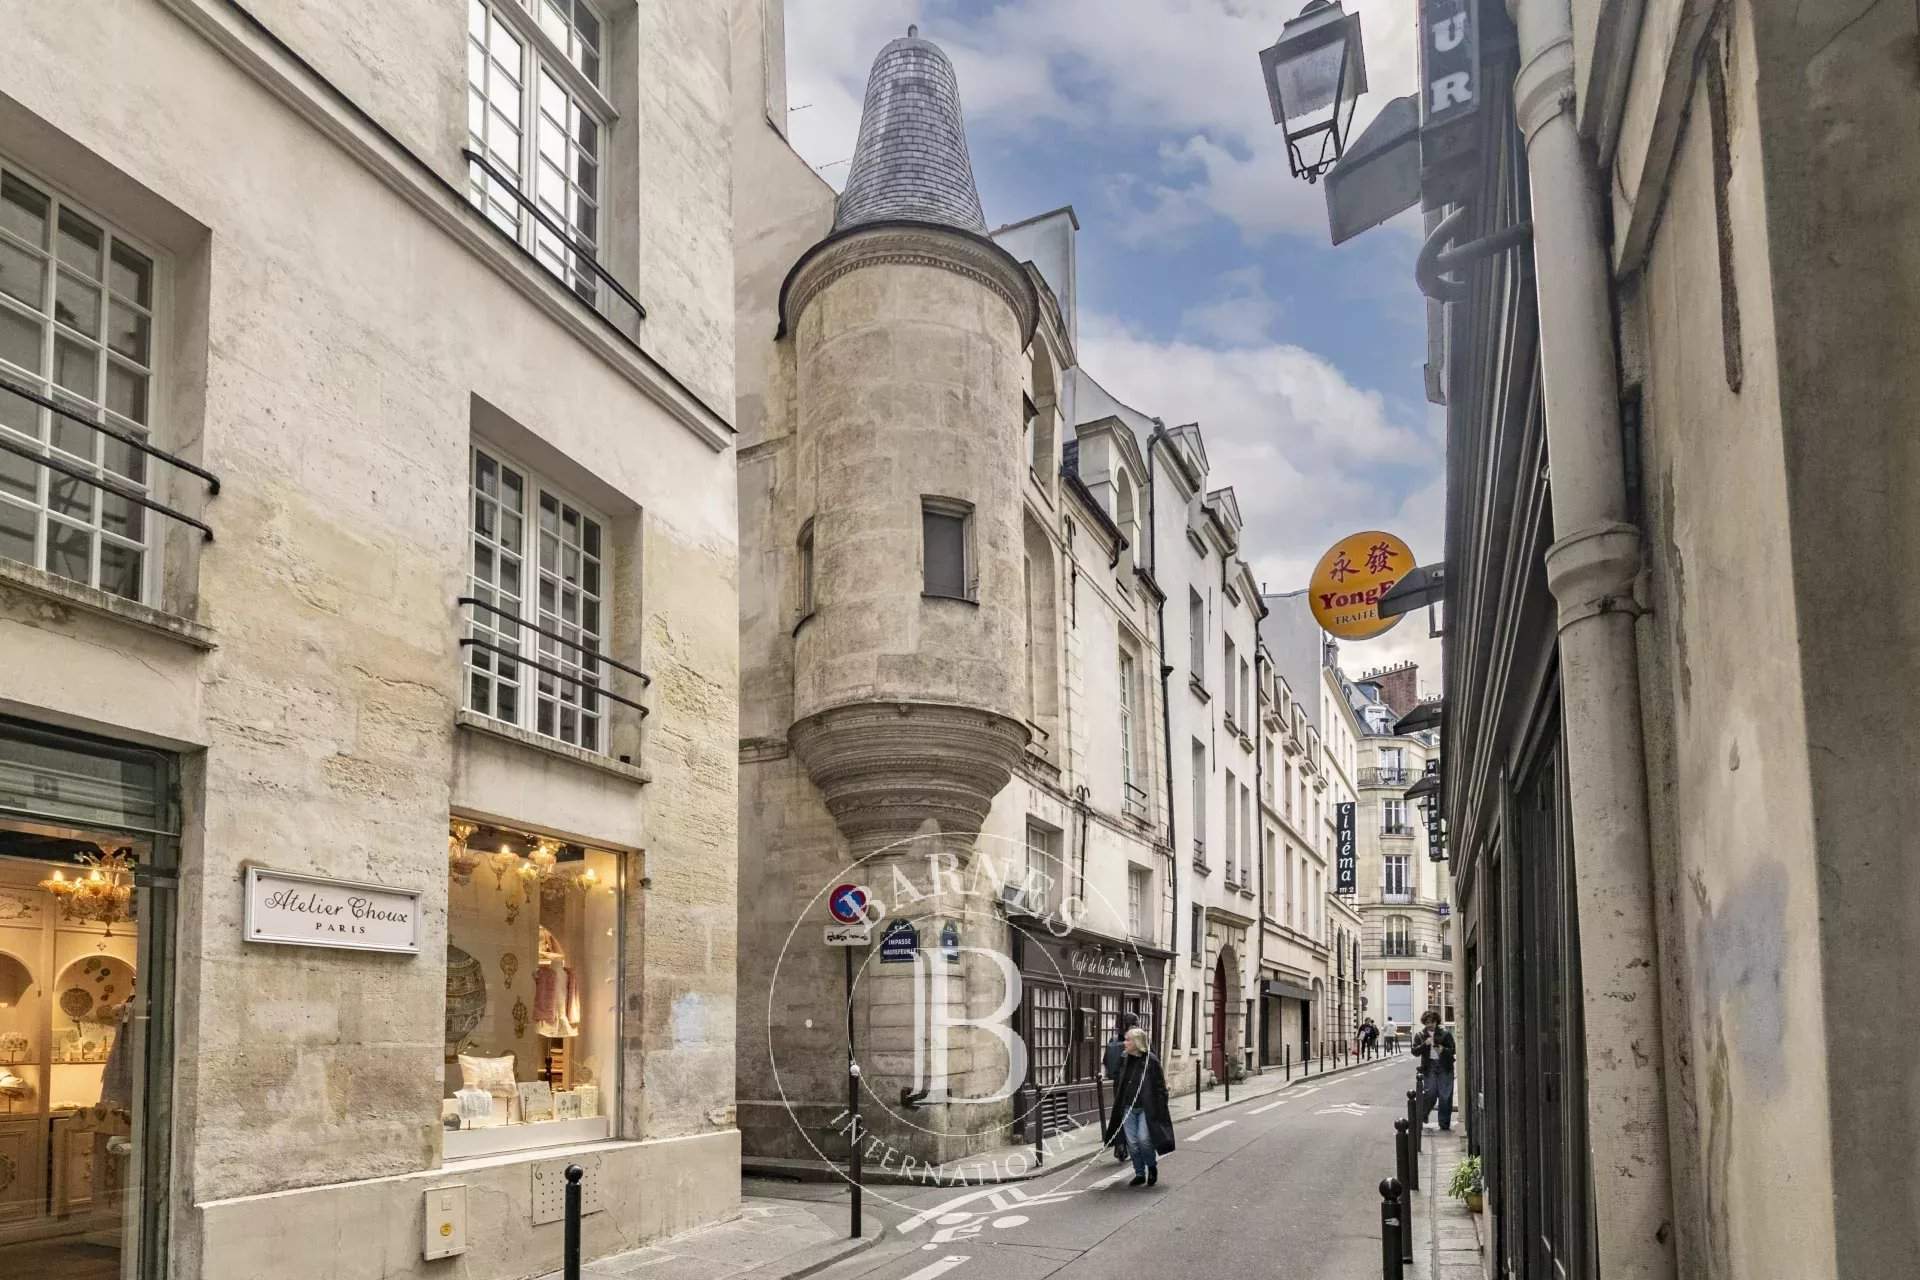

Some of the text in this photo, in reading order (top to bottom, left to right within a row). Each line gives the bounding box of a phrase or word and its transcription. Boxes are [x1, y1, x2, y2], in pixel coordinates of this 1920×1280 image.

[1329, 541, 1399, 584] 永發
[1335, 609, 1377, 625] TRAITE
[1339, 803, 1354, 882] cinéma
[263, 888, 408, 923] Atelier Choux
[315, 922, 367, 934] PARIS
[1071, 951, 1089, 977] Café
[1088, 957, 1097, 974] de
[1097, 956, 1105, 975] la
